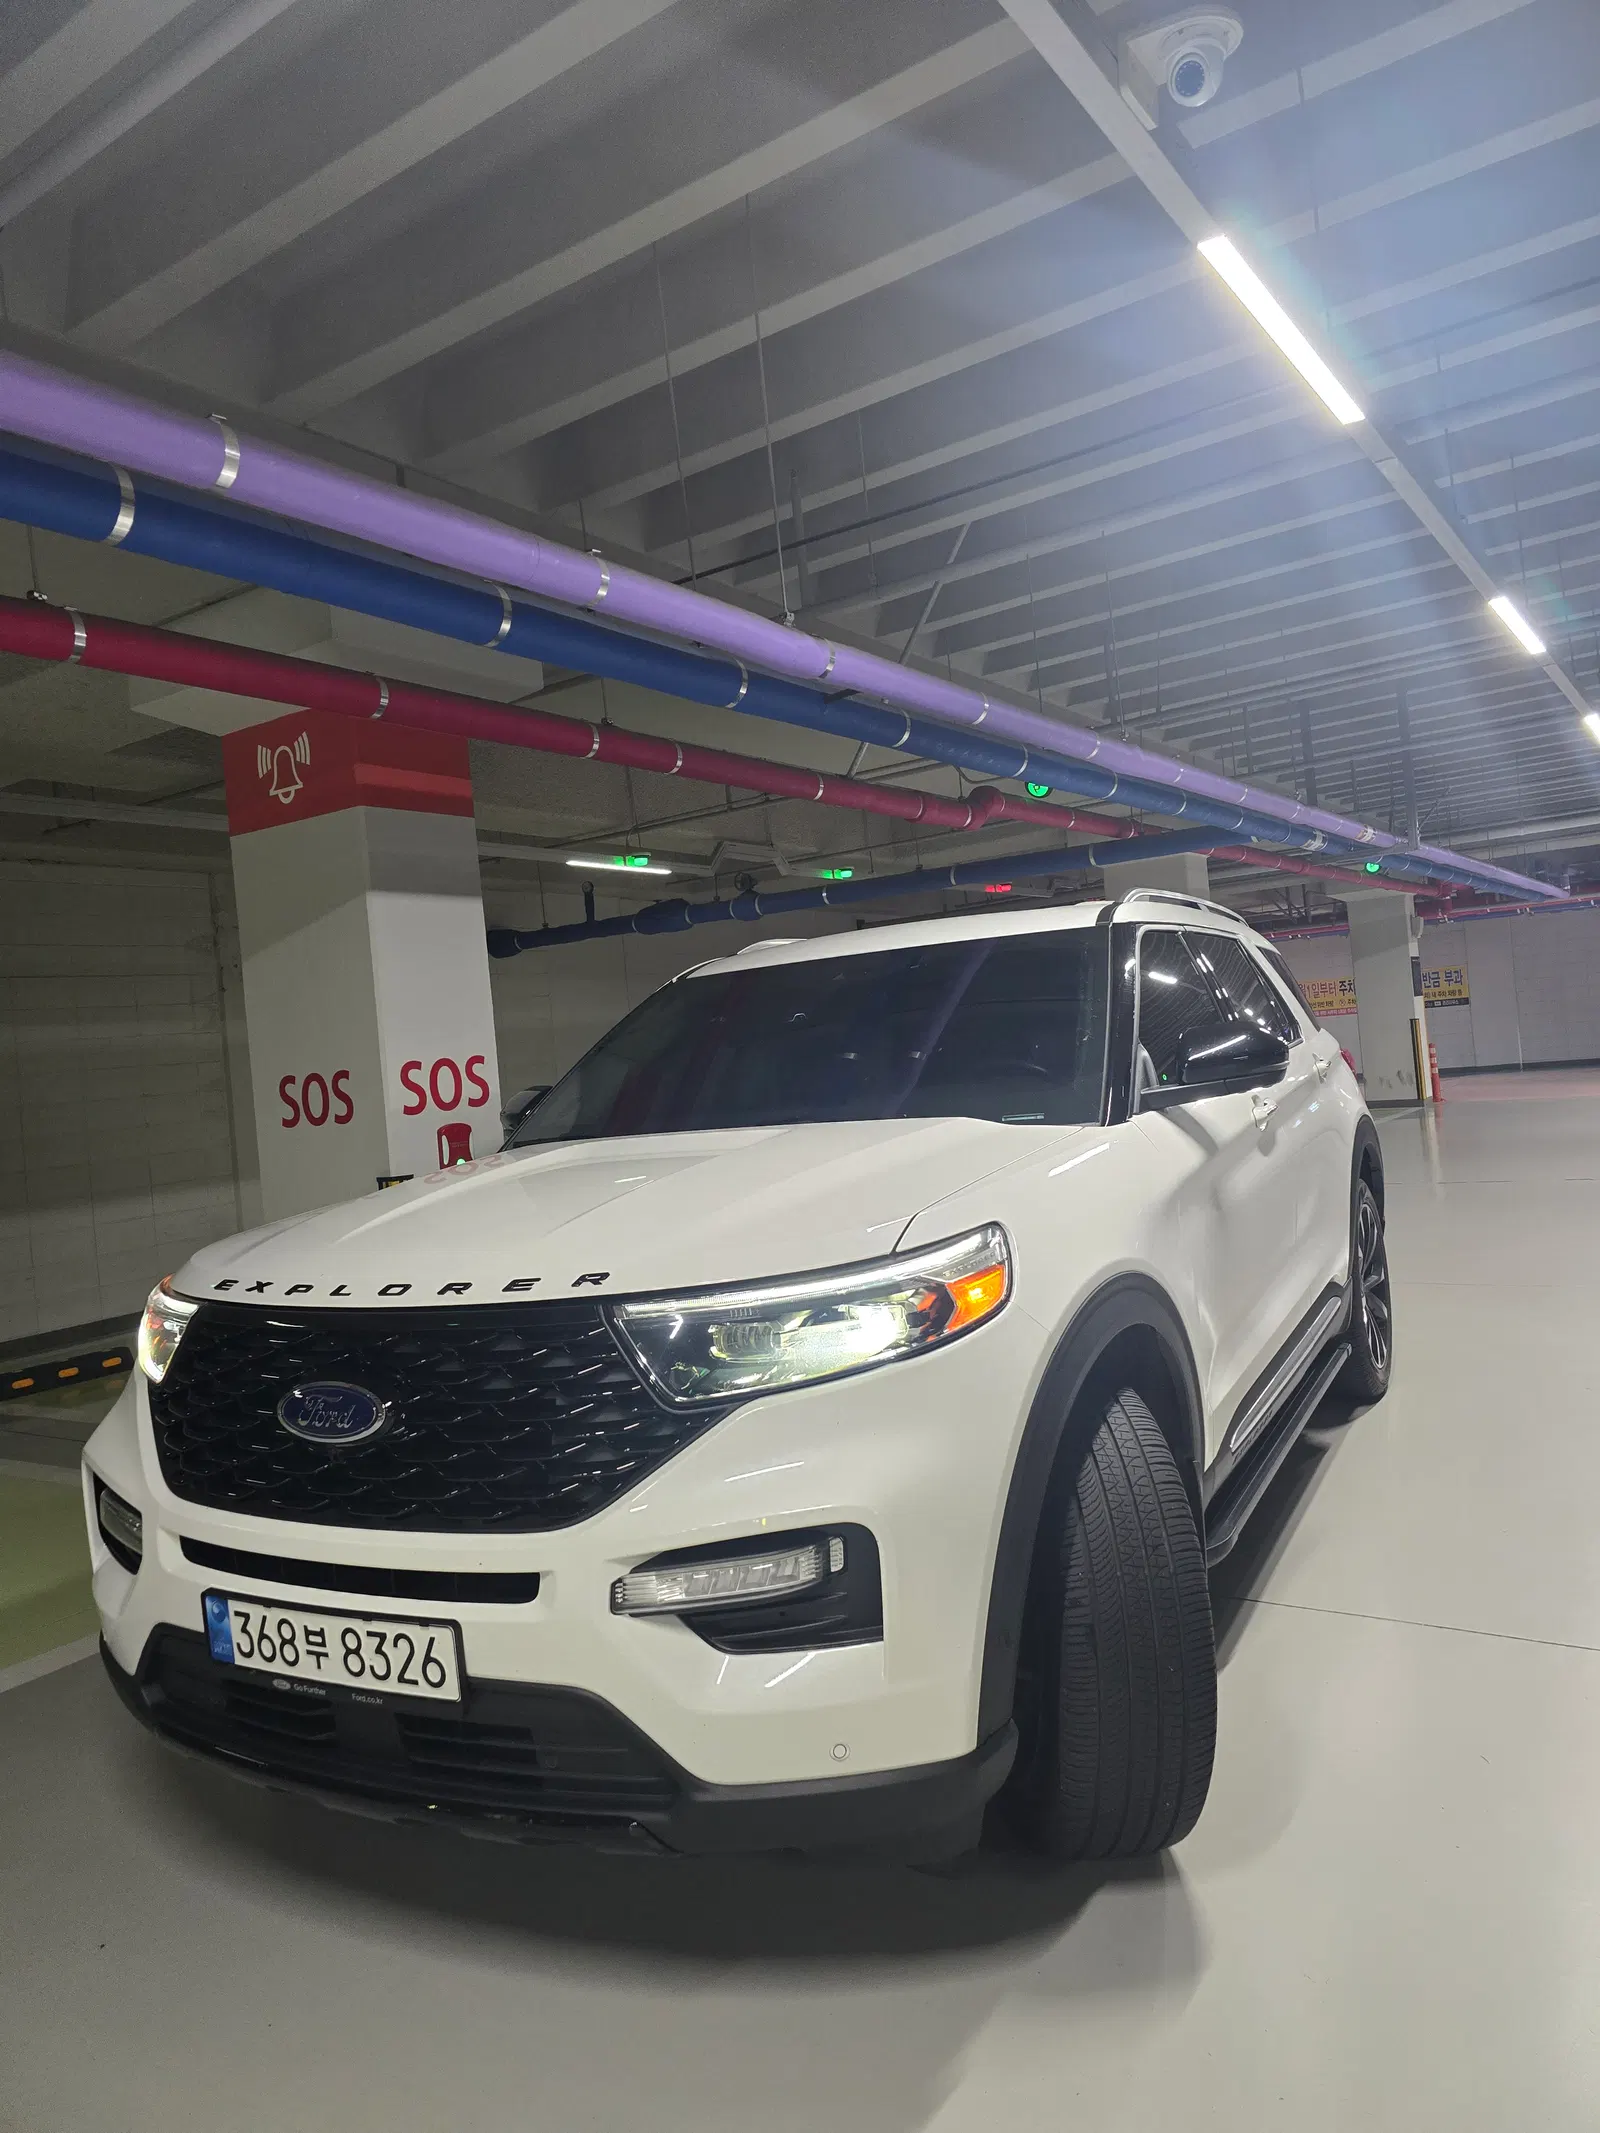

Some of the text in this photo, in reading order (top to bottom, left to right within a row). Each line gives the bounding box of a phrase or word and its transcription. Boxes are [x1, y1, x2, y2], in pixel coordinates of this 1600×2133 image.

[1444, 968, 1463, 987] 부과
[279, 1069, 354, 1128] SOS
[400, 1054, 490, 1115] SOS
[213, 1271, 611, 1297] EXPLORER
[298, 1394, 356, 1429] Ford
[233, 1610, 447, 1689] 368부 8326
[293, 1683, 304, 1693] Go
[303, 1684, 327, 1697] Further
[351, 1692, 384, 1705] Ford.co.kr
